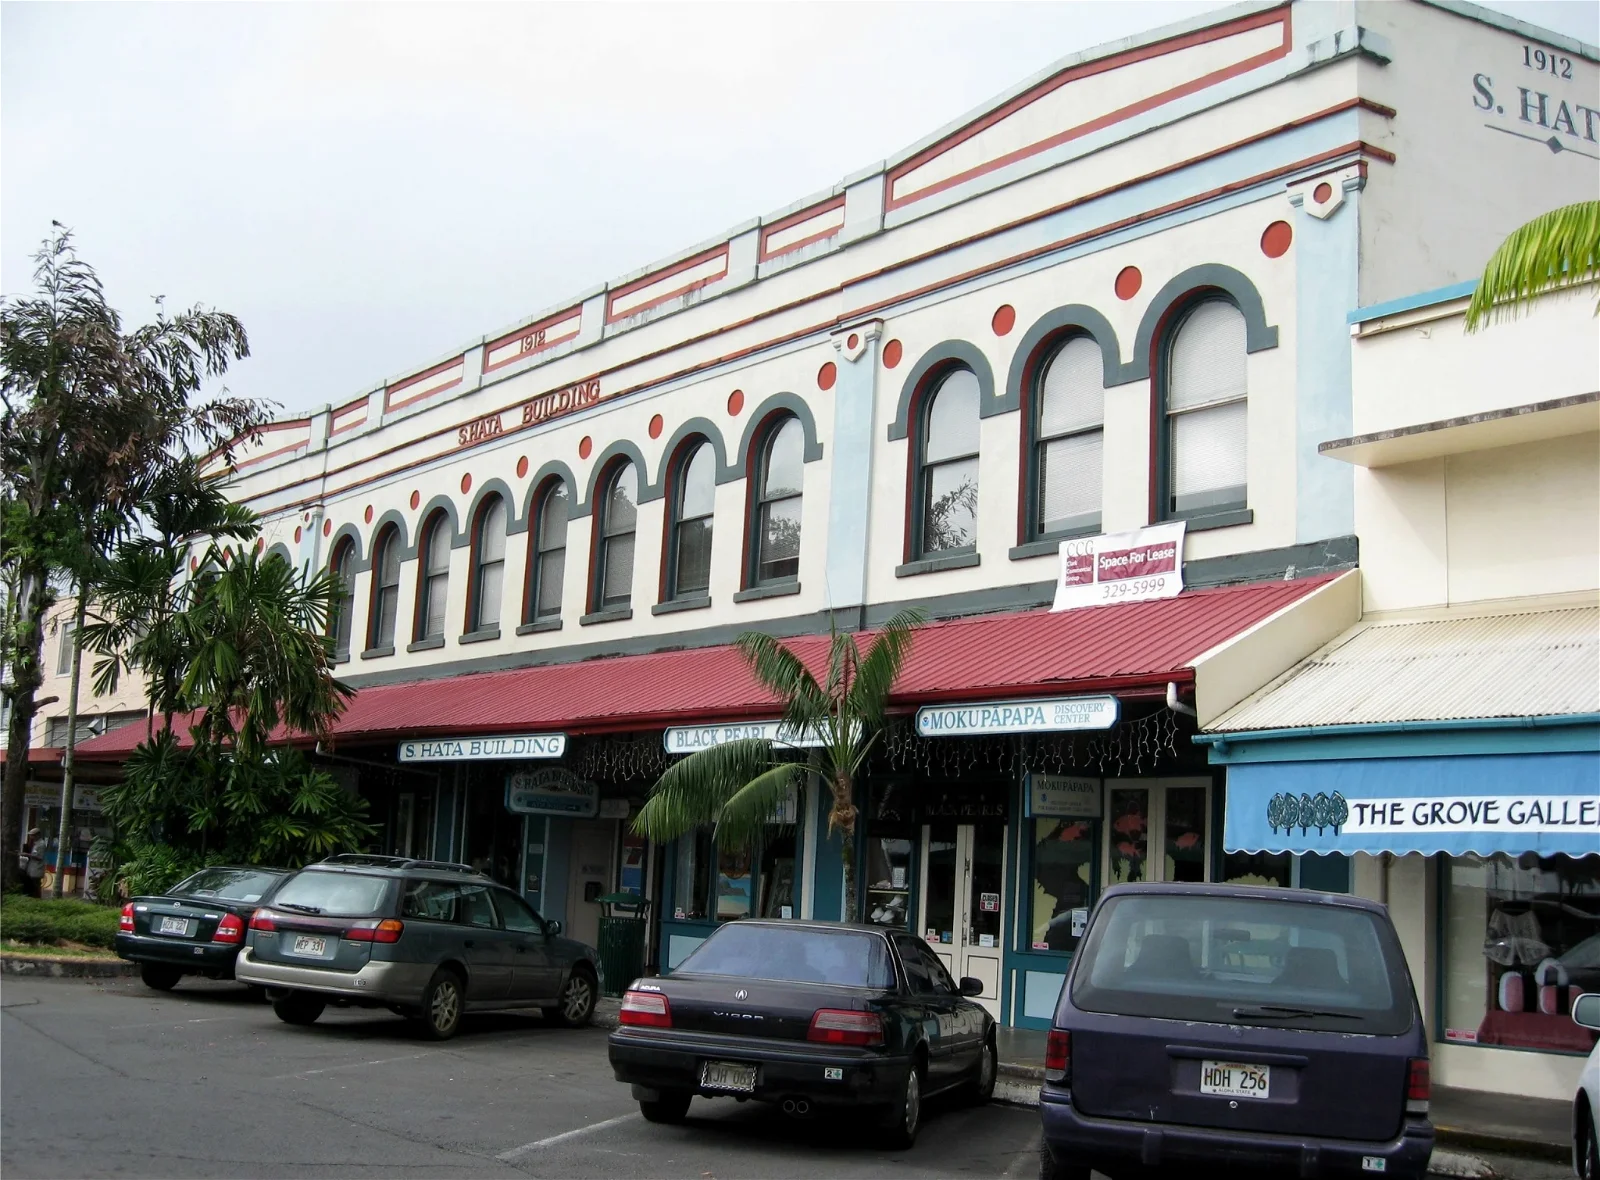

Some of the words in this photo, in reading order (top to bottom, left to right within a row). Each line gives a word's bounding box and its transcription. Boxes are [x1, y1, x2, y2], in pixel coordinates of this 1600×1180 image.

[1522, 45, 1573, 79] 1912
[1472, 73, 1504, 114] S.
[1517, 86, 1600, 142] HAT
[520, 330, 546, 354] 1912
[521, 380, 601, 425] BUILDING
[1066, 540, 1094, 557] CCG
[1100, 556, 1129, 570] Space
[1129, 551, 1145, 564] For
[1147, 547, 1175, 561] Lease
[1102, 577, 1166, 599] 329-5999
[1053, 714, 1091, 725] CENTER
[1054, 702, 1105, 714] DISCOVERY
[405, 744, 417, 758] S.
[421, 741, 464, 757] HATA
[469, 737, 559, 756] BUILDING
[676, 729, 719, 748] BLACK
[1353, 801, 1405, 826] THE
[1412, 800, 1500, 825] GROVE
[1507, 799, 1600, 826] GALLE
[1204, 1067, 1231, 1088] HDH
[1240, 1070, 1267, 1091] 256
